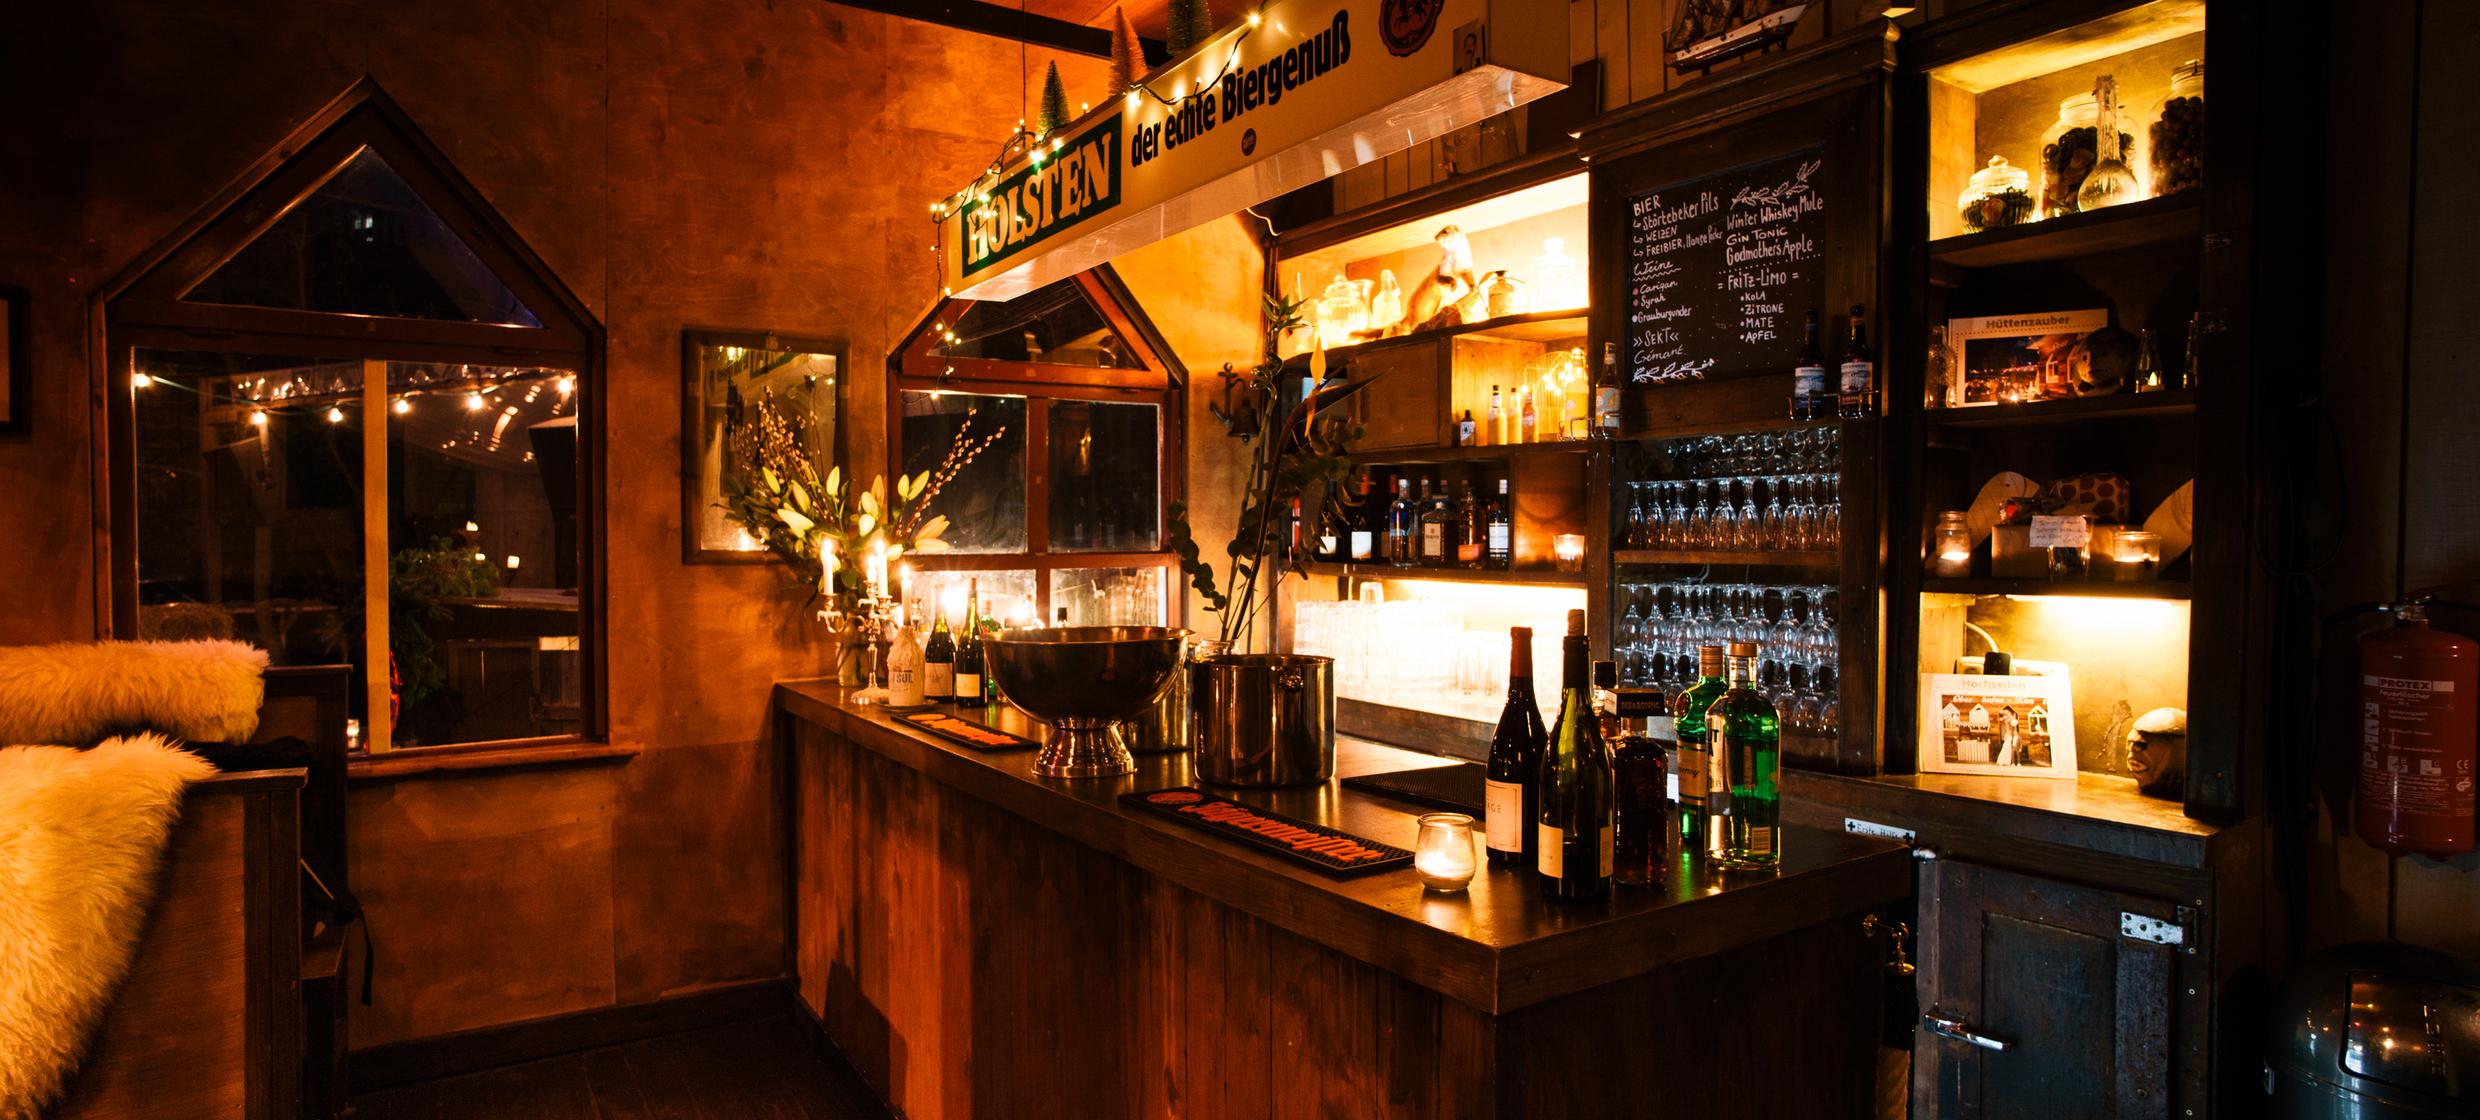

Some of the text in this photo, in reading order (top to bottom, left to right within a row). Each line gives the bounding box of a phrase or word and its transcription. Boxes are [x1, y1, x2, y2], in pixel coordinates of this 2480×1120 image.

[1131, 123, 1161, 168] der
[1164, 93, 1216, 151] echte
[1222, 9, 1350, 124] Biergenuß
[967, 132, 1112, 265] HOLSTEN
[1633, 195, 1661, 216] BIER
[1642, 191, 1719, 230] Störtebeker Pils
[1726, 190, 1823, 231] Winter Whiskey Mule
[1645, 225, 1678, 242] WEIZEN
[1782, 233, 1814, 262] Apple
[1634, 260, 1674, 276] Weine
[1641, 293, 1666, 309] Syrah
[1637, 305, 1692, 323] Grauburgunder
[1745, 316, 1774, 328] MATE
[1985, 315, 2071, 329] Hüttenzauber
[1962, 679, 2027, 690] Hochzeiten
[2380, 678, 2430, 690] PROTEX
